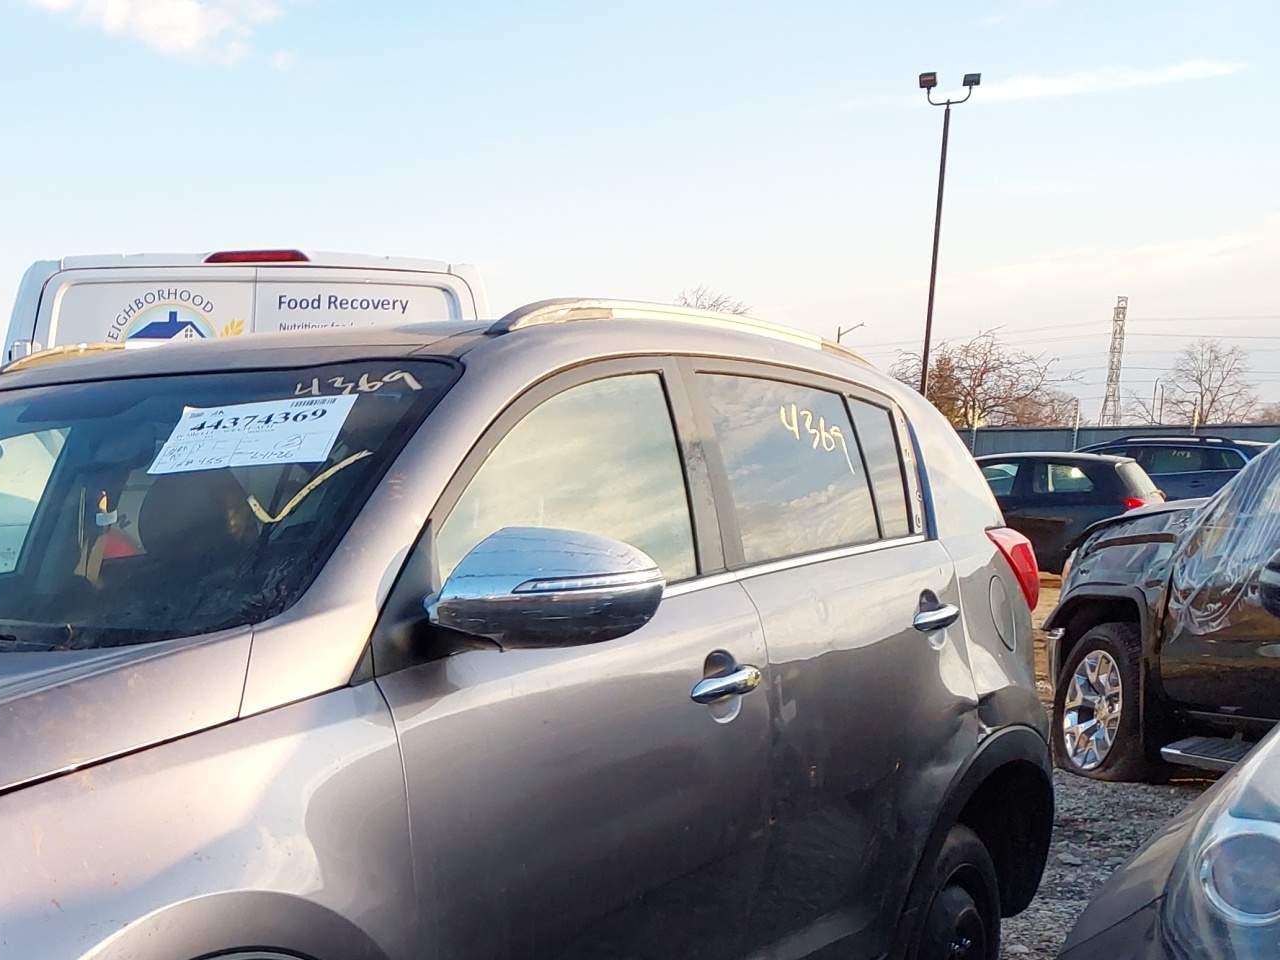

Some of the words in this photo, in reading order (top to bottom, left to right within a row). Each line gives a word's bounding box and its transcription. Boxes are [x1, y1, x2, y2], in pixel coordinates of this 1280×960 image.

[106, 288, 214, 342] EIGHBORHOOD
[278, 294, 322, 311] Food
[327, 294, 409, 314] Recovery
[293, 369, 423, 396] 4369
[190, 408, 328, 432] 44374369
[780, 402, 856, 475] 4369
